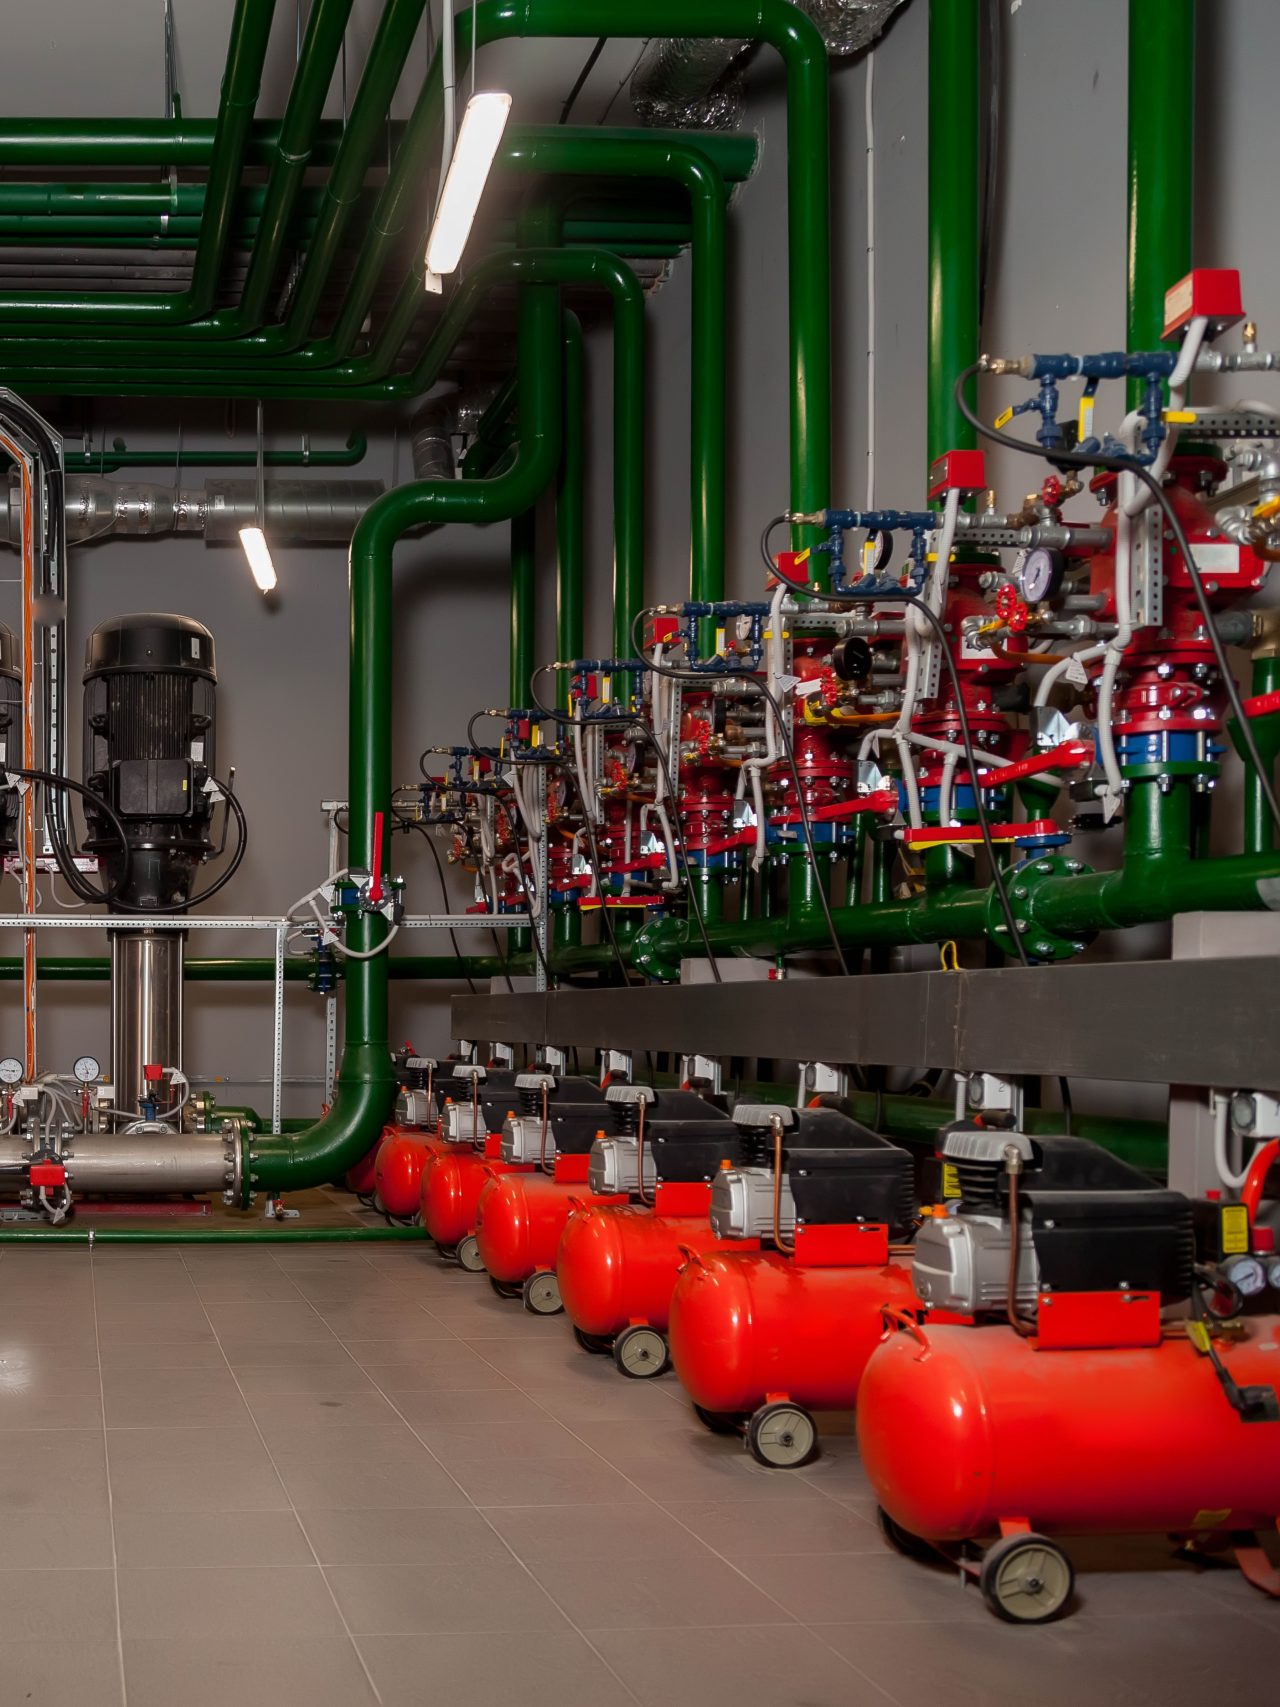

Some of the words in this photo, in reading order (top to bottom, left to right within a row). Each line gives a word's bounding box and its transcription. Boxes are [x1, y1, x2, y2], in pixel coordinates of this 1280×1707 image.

[704, 1059, 710, 1068] 4
[826, 1067, 833, 1078] 3
[998, 1081, 1007, 1093] 2
